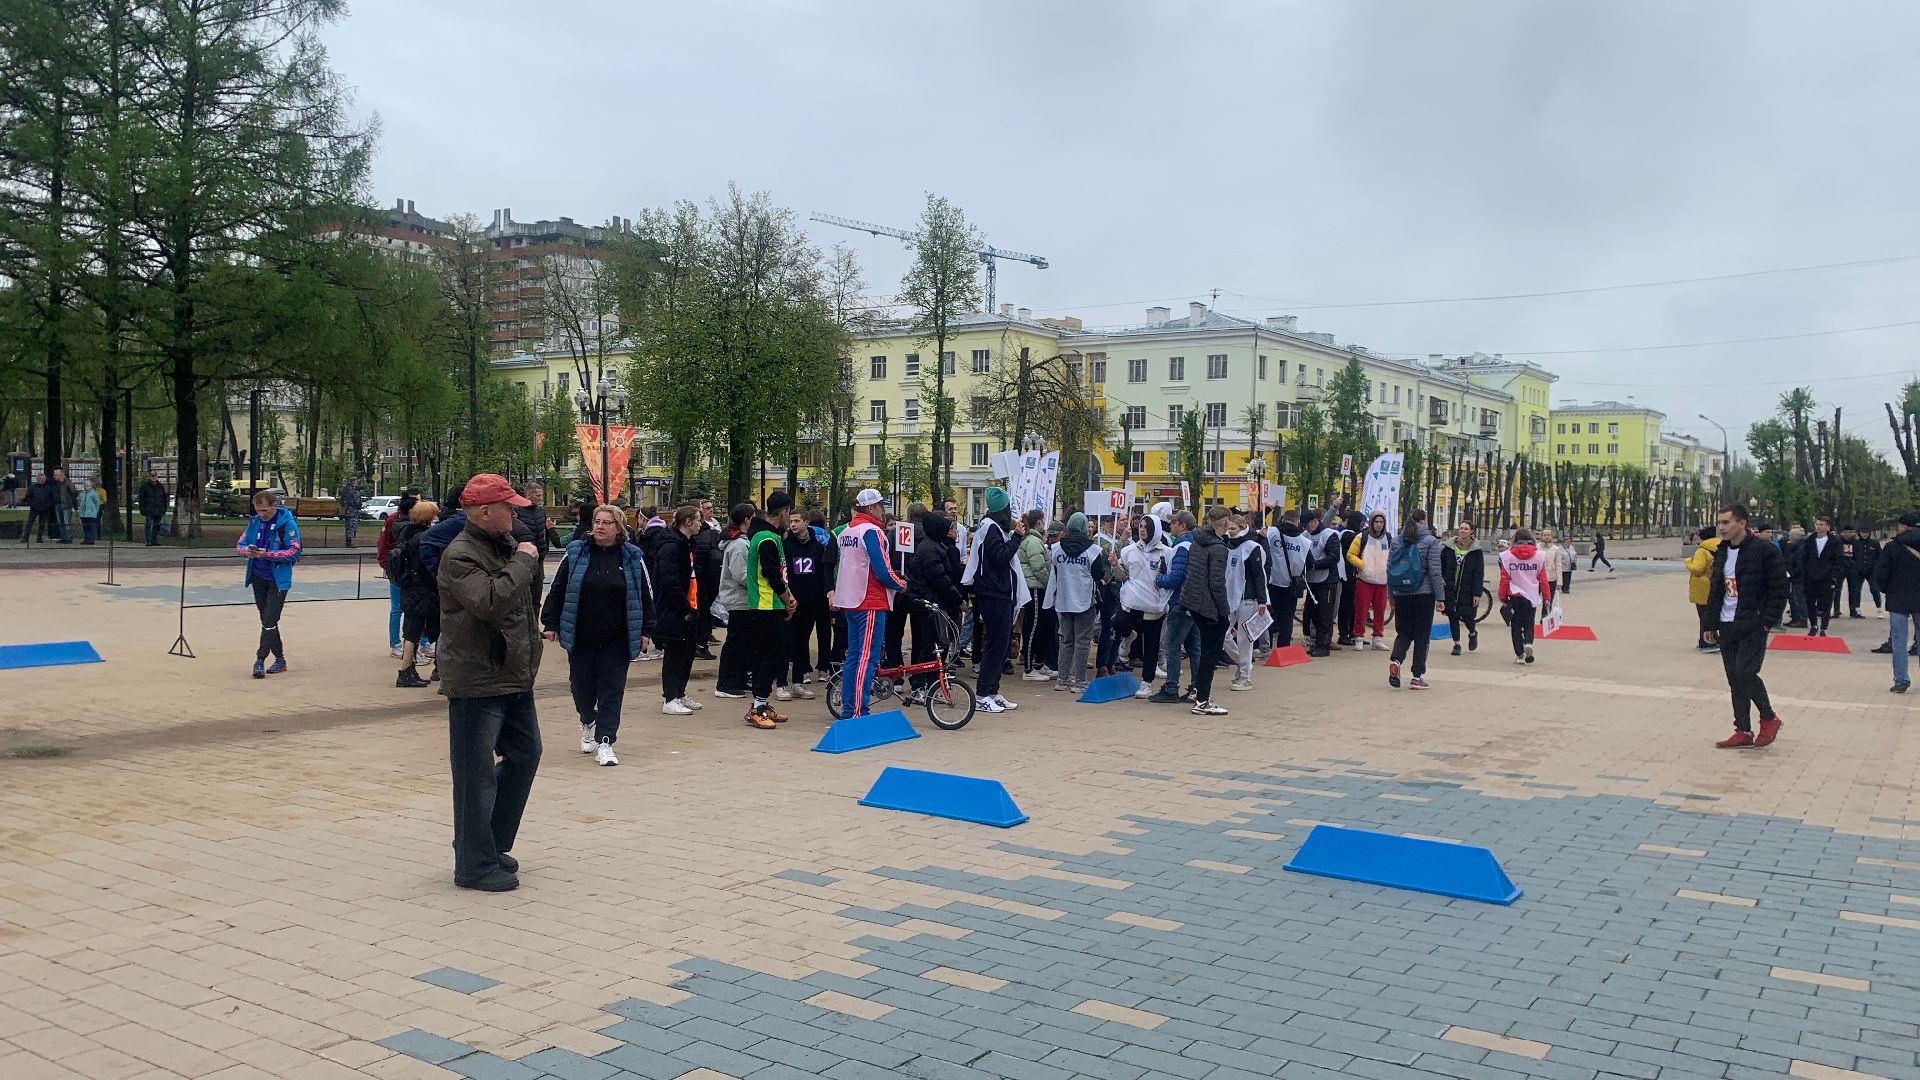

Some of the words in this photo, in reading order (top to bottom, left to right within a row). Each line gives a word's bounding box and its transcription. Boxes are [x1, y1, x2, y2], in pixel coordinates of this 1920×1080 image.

[1112, 493, 1125, 508] 10
[899, 527, 911, 546] 12
[1274, 539, 1300, 552] СДЬЯ
[795, 557, 813, 573] 12
[1509, 563, 1538, 571] СУДЬЯ
